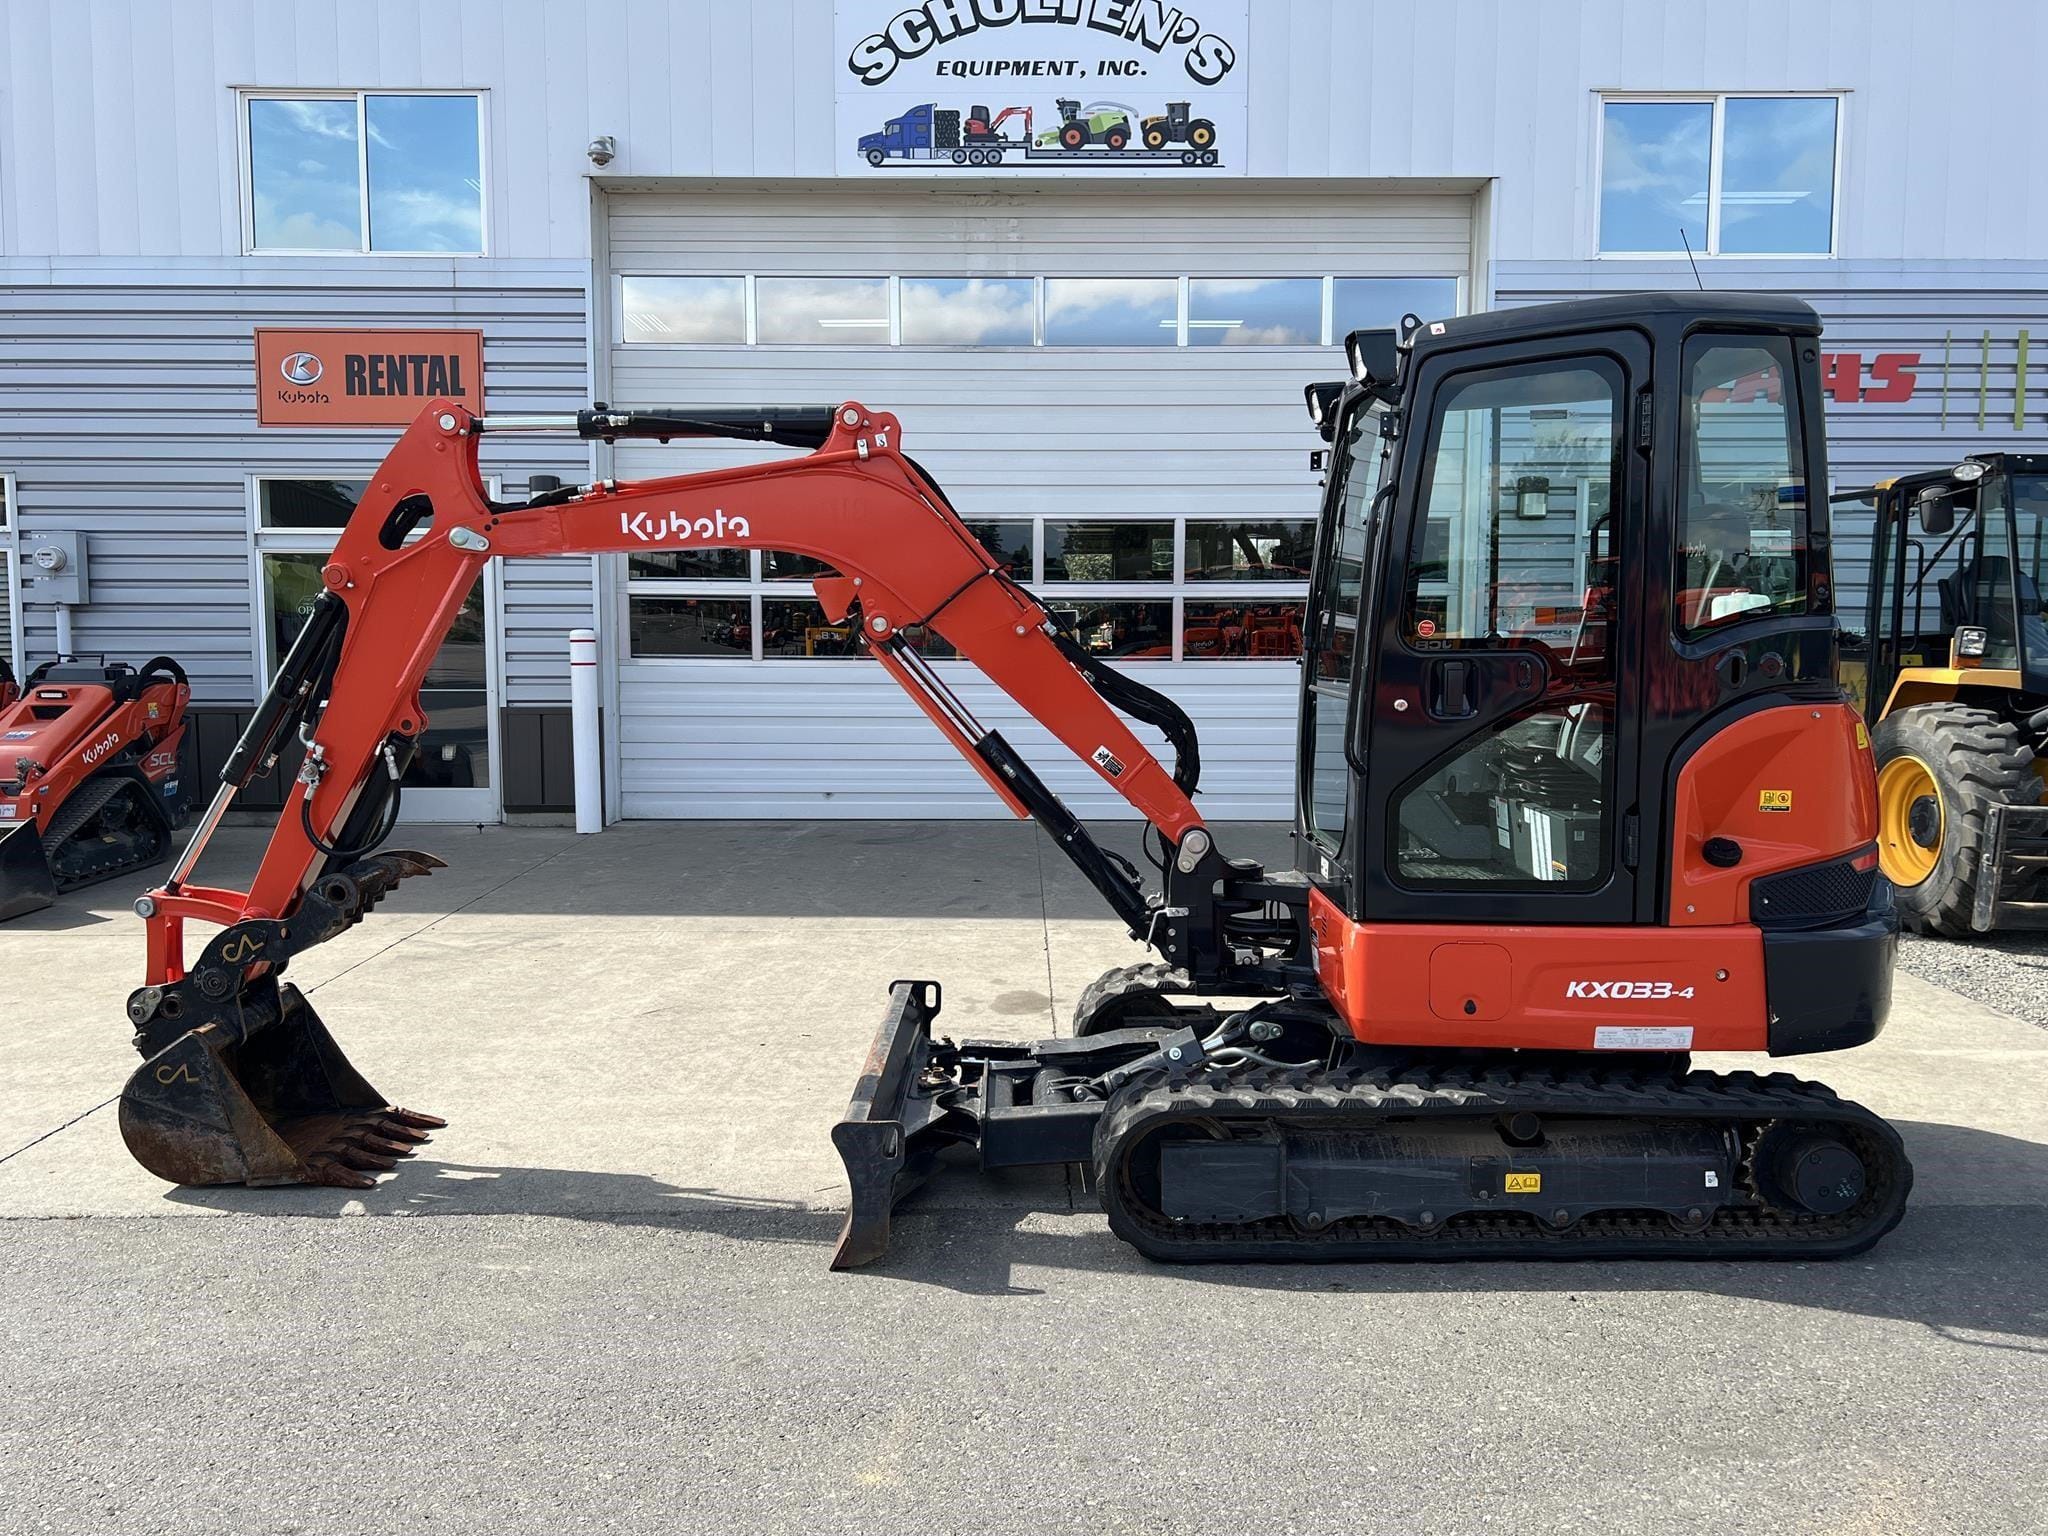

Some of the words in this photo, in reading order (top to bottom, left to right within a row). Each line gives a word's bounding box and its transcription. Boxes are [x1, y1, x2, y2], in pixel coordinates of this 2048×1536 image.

[936, 60, 1087, 79] EQUIPMENT,
[1097, 60, 1148, 76] INC.
[345, 354, 466, 396] RENTAL
[278, 390, 329, 403] Kubota
[620, 509, 750, 541] Kubota
[297, 605, 313, 615] OP
[82, 733, 119, 764] Kubota
[150, 752, 175, 767] SCL
[1565, 981, 1694, 999] KX033-4
